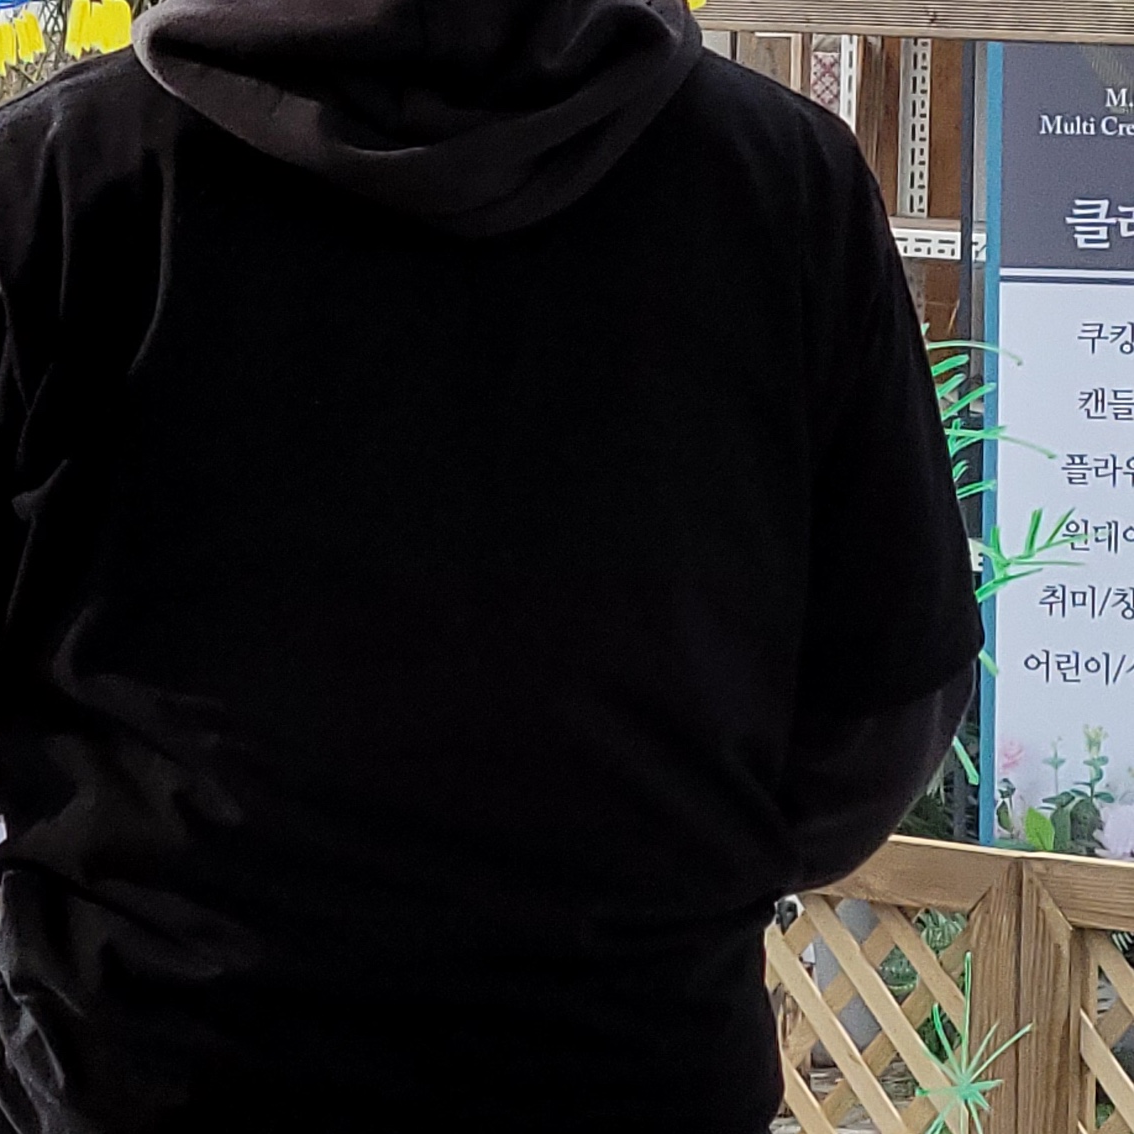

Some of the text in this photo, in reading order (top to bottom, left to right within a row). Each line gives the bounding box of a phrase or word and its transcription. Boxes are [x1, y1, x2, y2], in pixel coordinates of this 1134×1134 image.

[1039, 114, 1096, 136] Multi
[1078, 387, 1134, 421] 캔들
[1024, 649, 1134, 686] 어린이/
